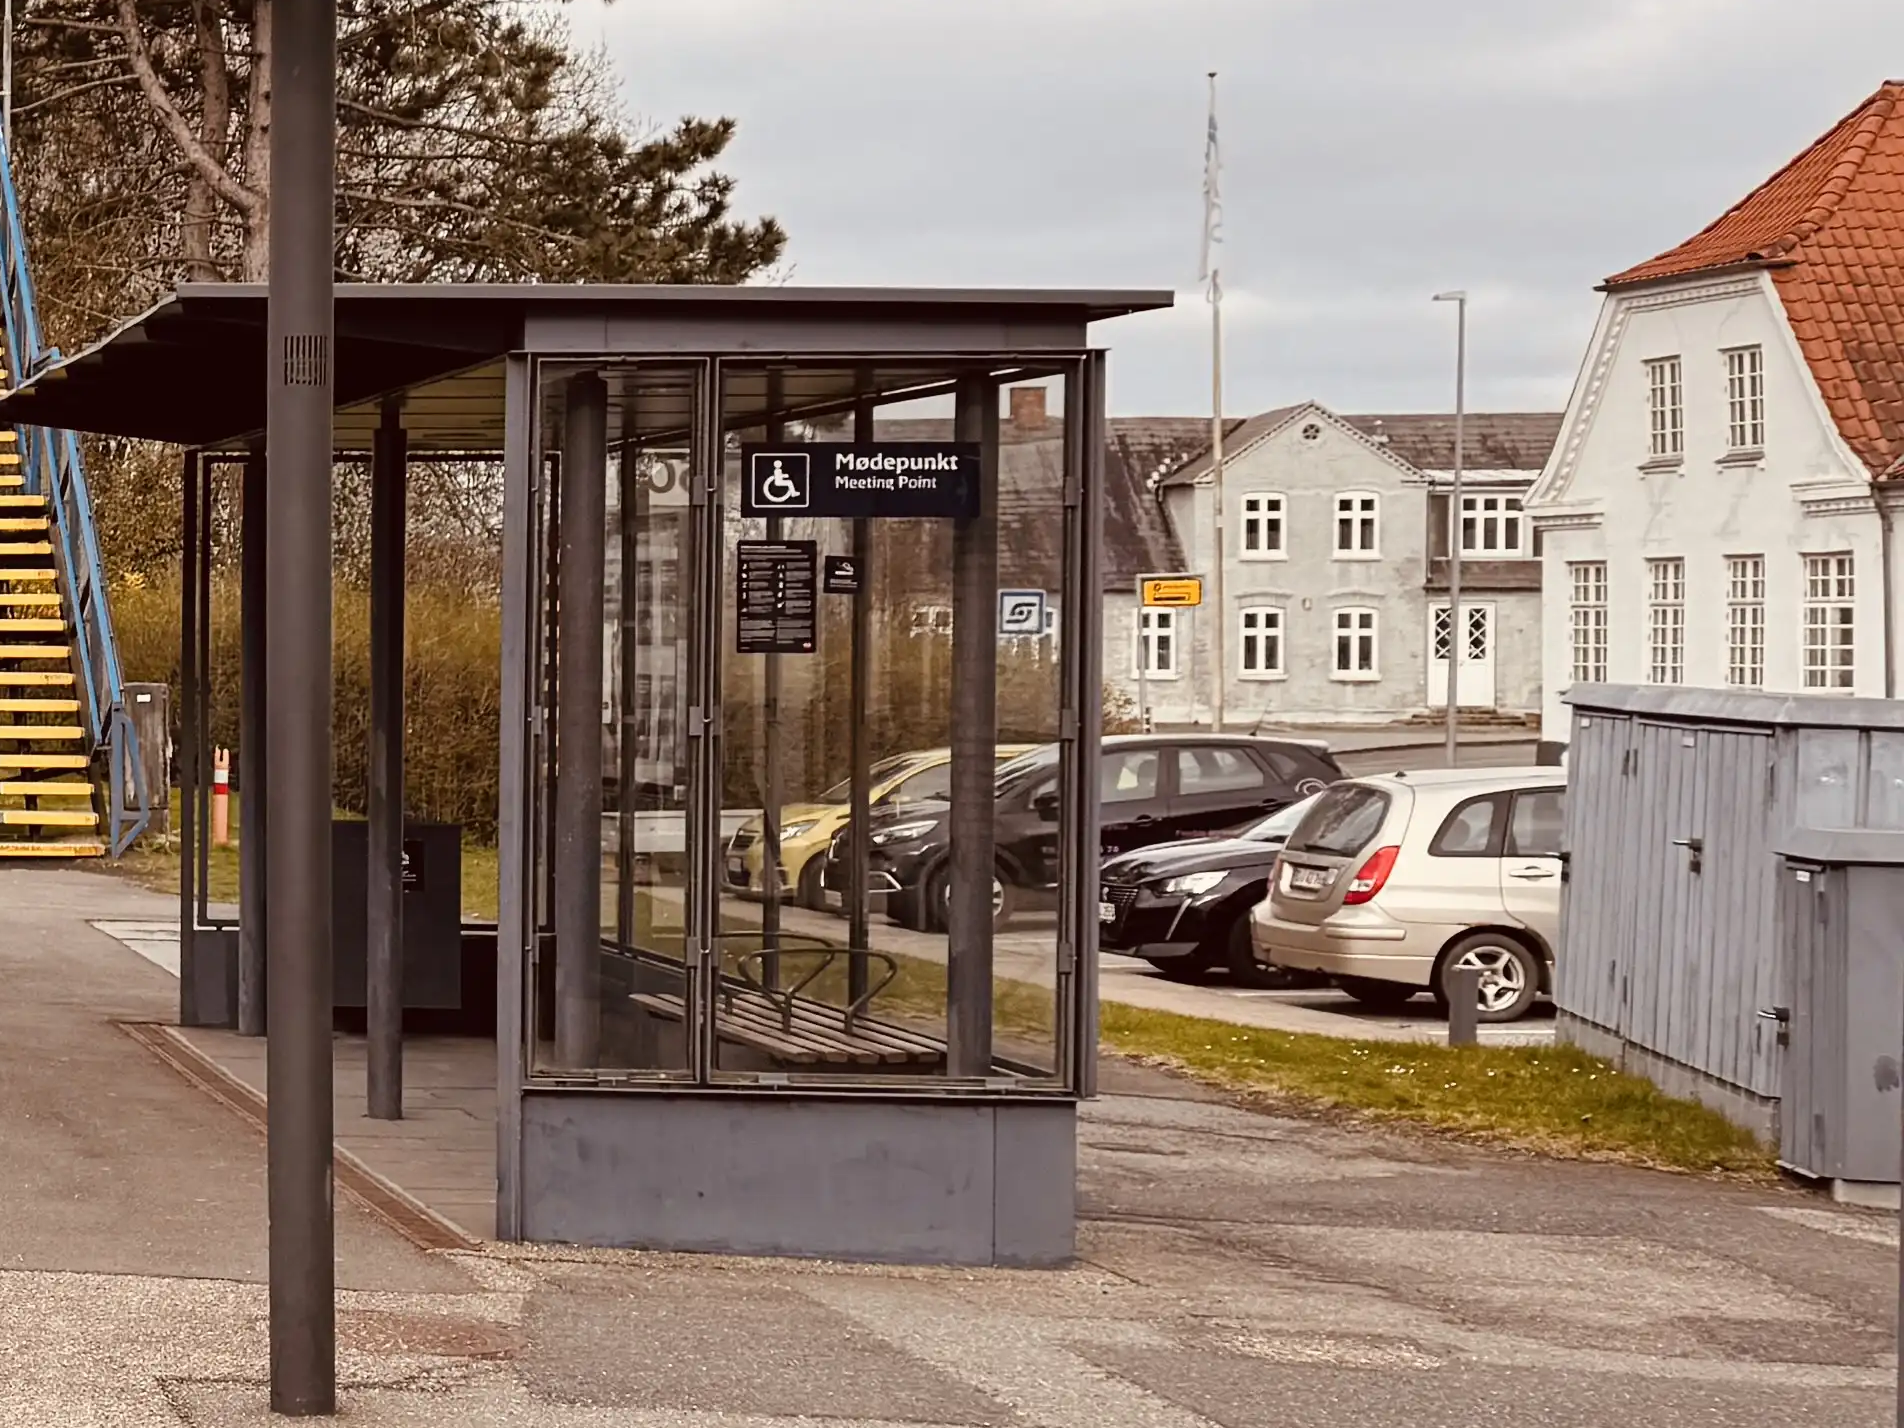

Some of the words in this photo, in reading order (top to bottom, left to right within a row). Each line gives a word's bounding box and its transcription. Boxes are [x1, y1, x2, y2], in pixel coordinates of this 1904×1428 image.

[835, 452, 959, 474] Mødepunkt
[835, 475, 895, 491] Meeting
[898, 475, 937, 489] Point
